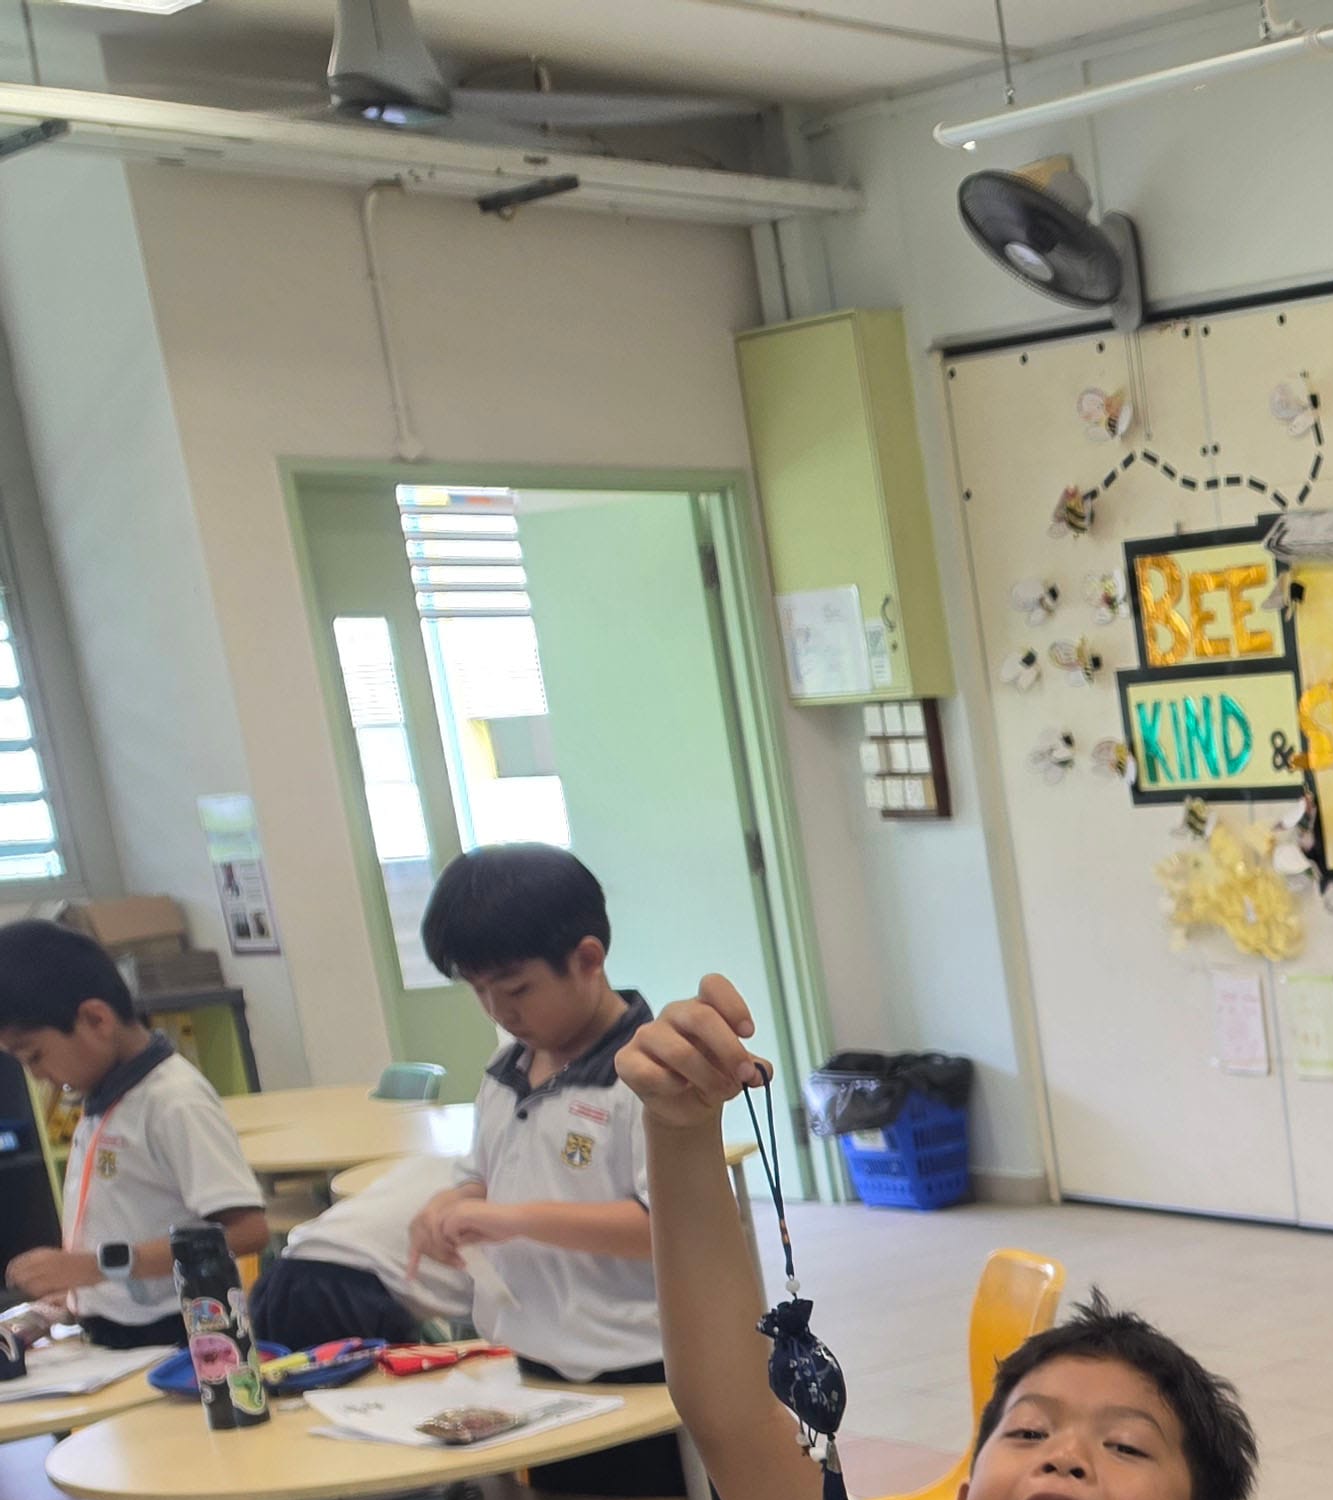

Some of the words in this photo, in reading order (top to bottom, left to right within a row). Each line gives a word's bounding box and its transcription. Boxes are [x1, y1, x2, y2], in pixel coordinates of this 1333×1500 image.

[1135, 554, 1275, 668] BEE
[1136, 692, 1253, 784] KIND
[1269, 730, 1297, 773] &
